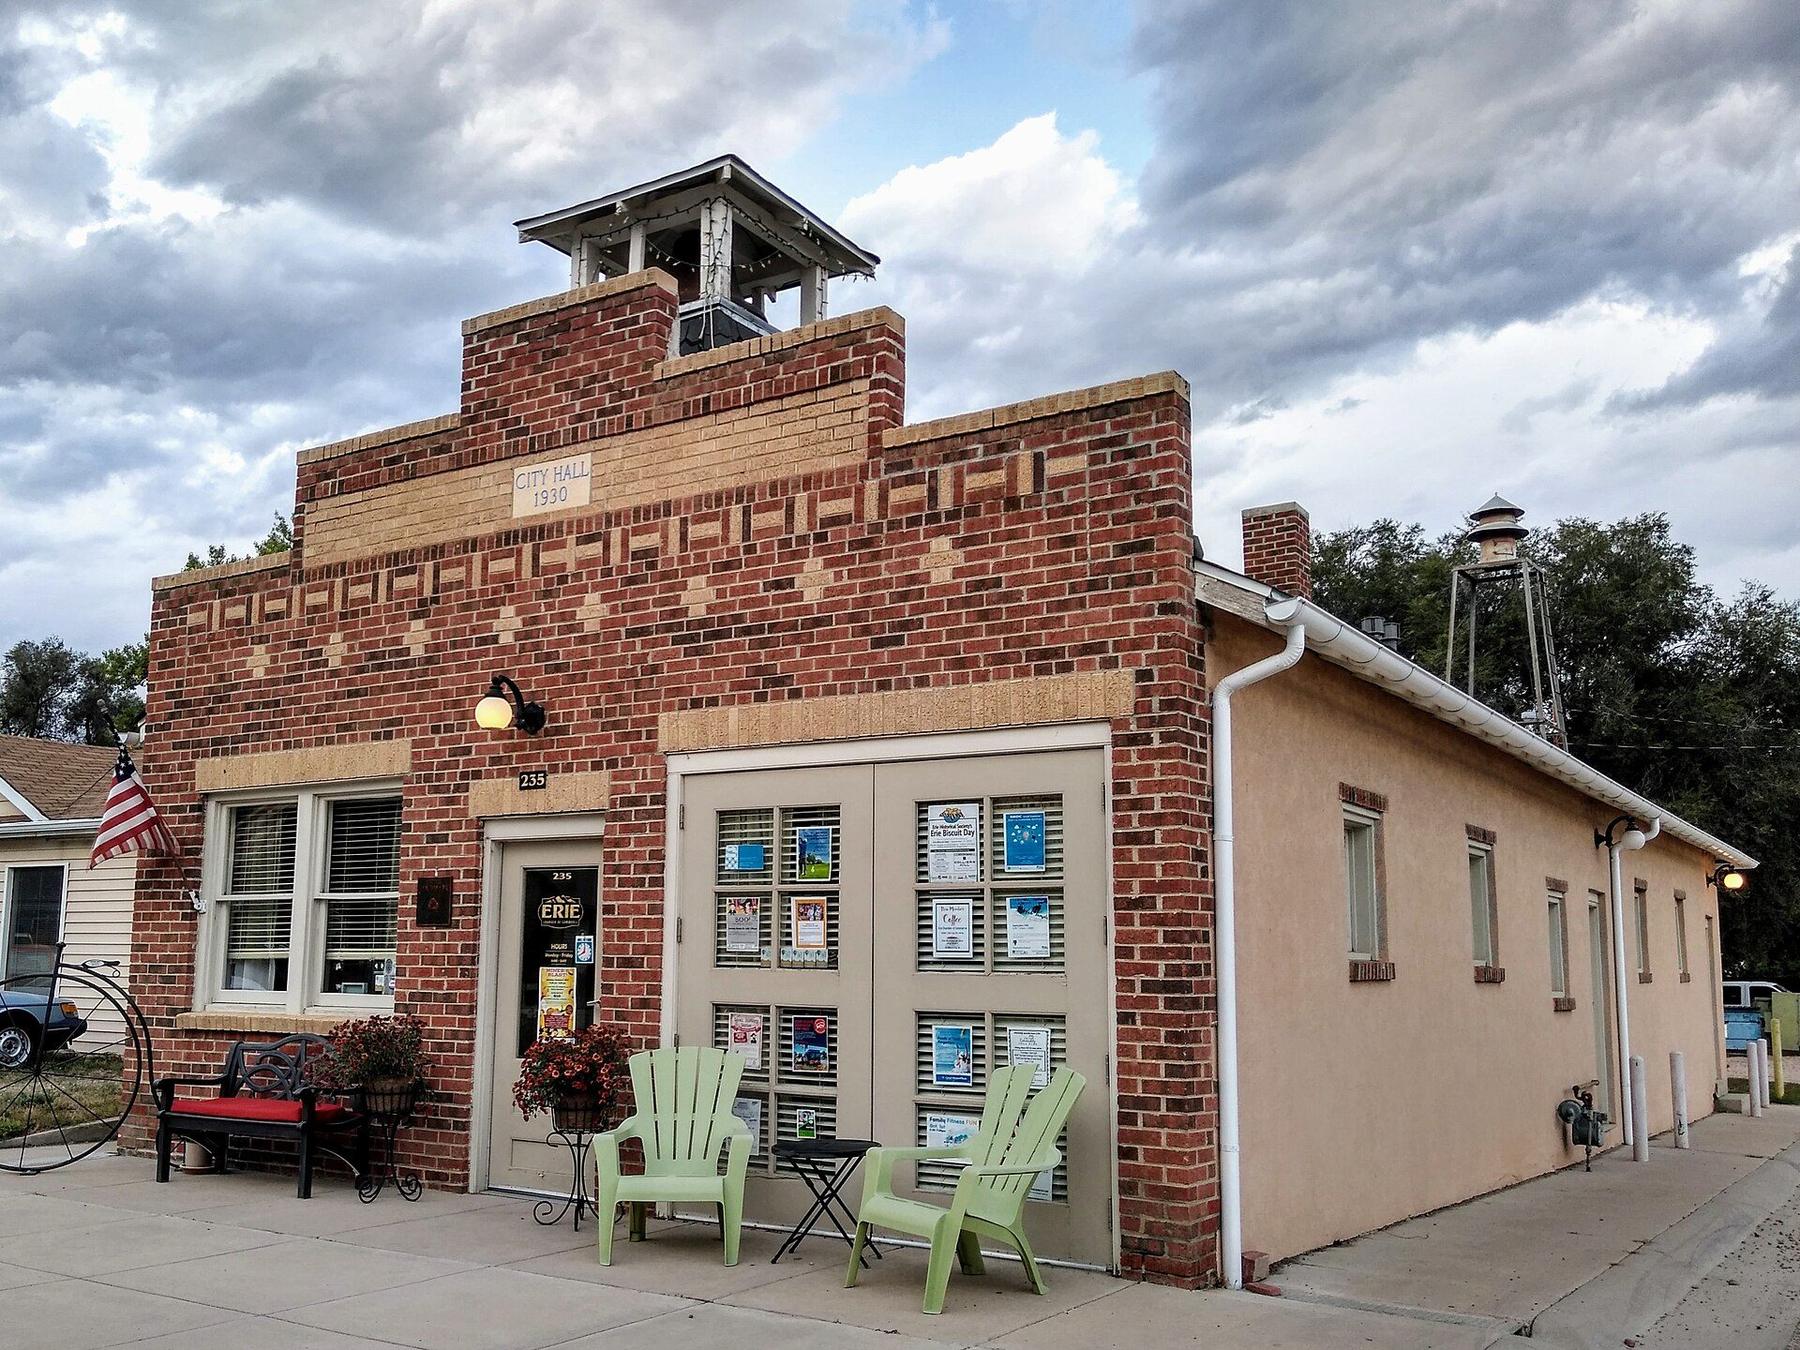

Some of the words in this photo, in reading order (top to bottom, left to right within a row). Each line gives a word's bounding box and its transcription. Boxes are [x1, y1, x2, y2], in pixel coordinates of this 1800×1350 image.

[515, 469, 549, 490] CITY
[553, 461, 590, 483] HALL
[533, 486, 568, 507] 1930
[521, 773, 545, 787] 235
[942, 829, 963, 837] Biscuit
[963, 828, 975, 838] Day
[552, 872, 572, 880] 235
[541, 904, 581, 919] ERIE
[929, 1116, 946, 1124] Family
[946, 1117, 965, 1125] Fitness
